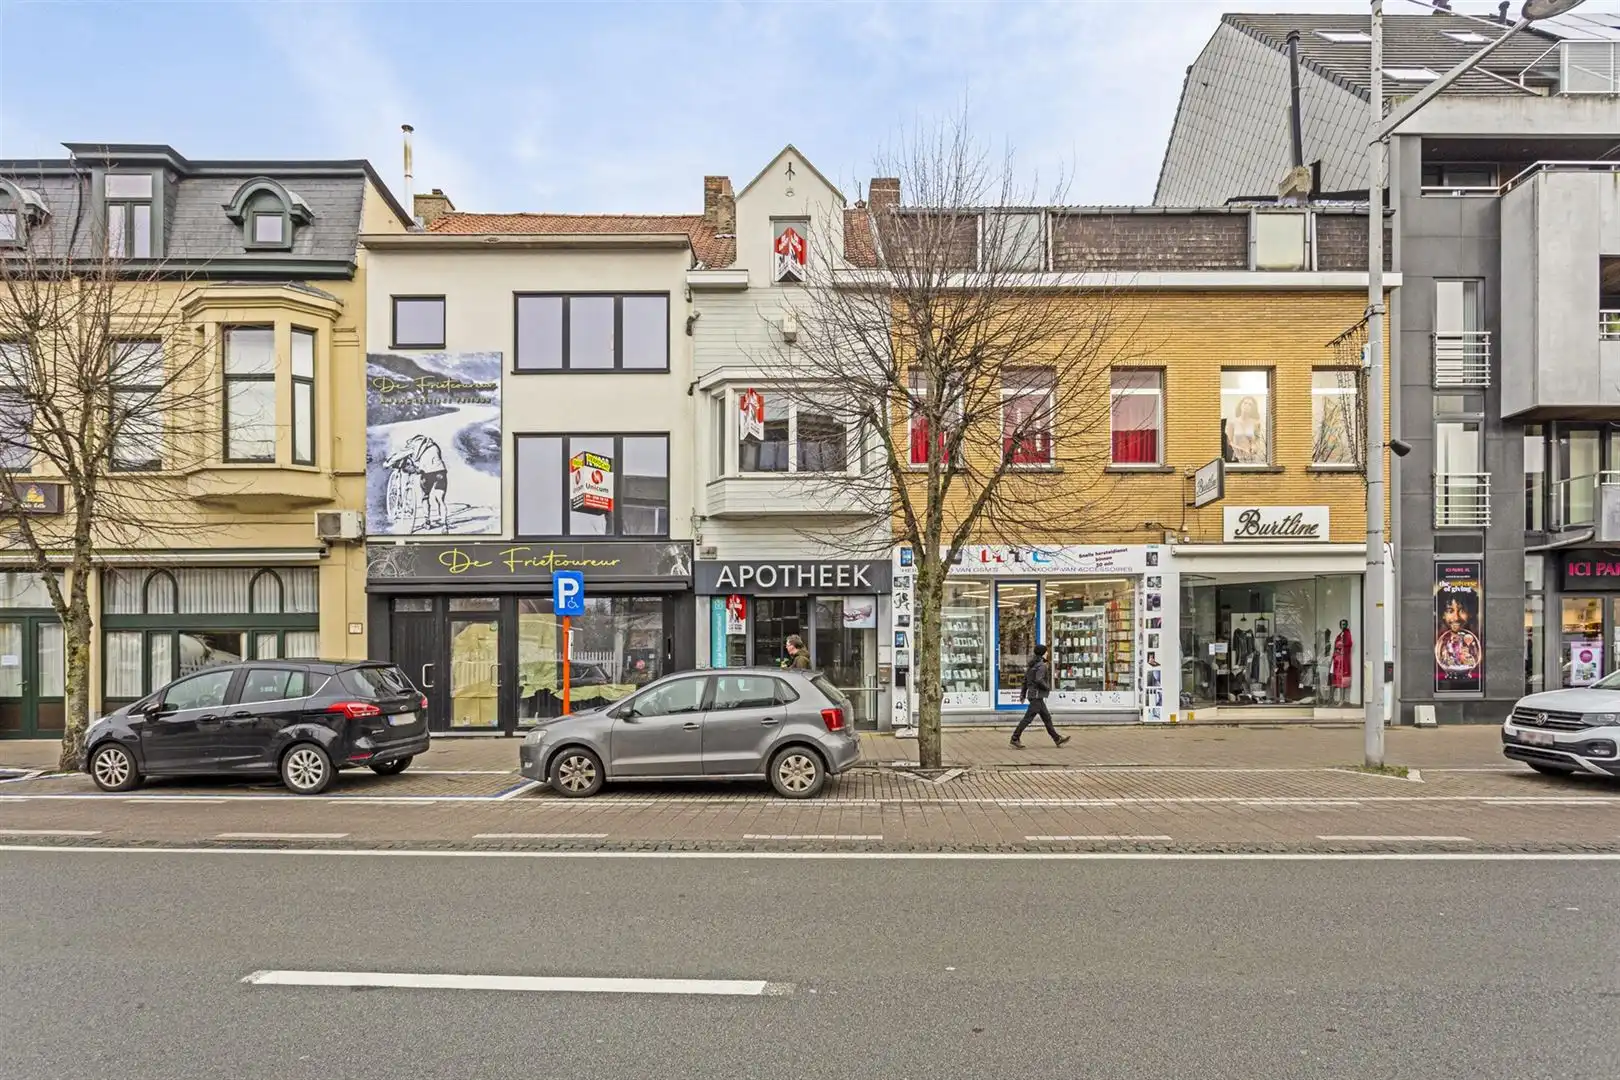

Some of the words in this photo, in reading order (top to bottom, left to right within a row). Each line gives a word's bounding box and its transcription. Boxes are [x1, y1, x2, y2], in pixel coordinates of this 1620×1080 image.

[373, 376, 409, 393] De
[585, 482, 610, 494] Unicum
[1234, 508, 1321, 536] Burtline
[438, 548, 492, 574] De
[499, 547, 620, 574] Frietcoureur
[1568, 562, 1591, 576] ICI
[715, 564, 872, 588] APOTHEEK
[558, 577, 580, 609] P
